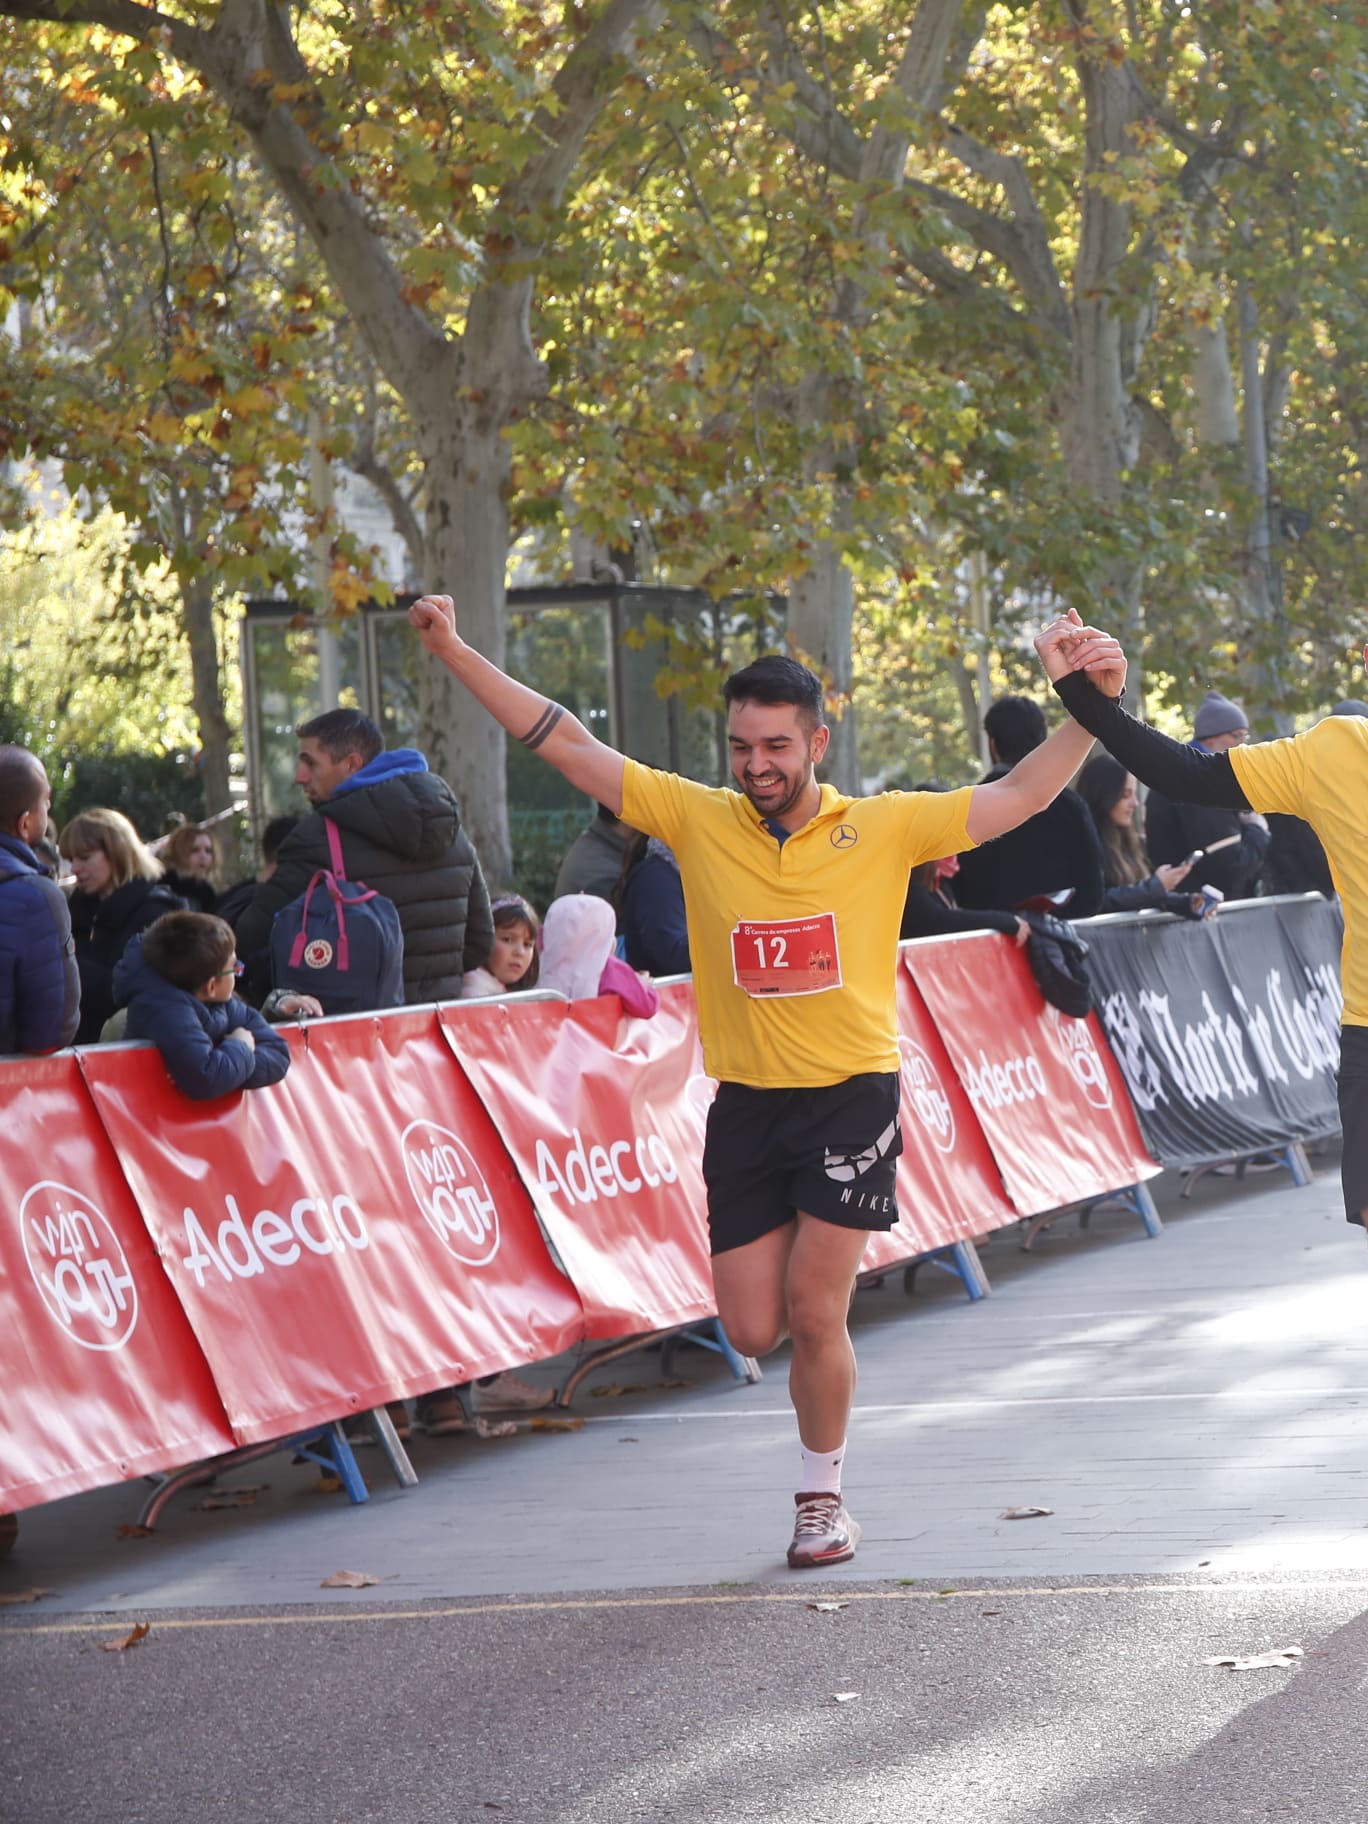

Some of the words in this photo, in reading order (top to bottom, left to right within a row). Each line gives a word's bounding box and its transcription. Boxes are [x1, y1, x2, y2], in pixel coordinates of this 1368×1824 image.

[754, 936, 789, 968] 12
[962, 1049, 1047, 1110] Adecco
[535, 1127, 679, 1207] Adecco
[840, 1187, 889, 1213] NIKE
